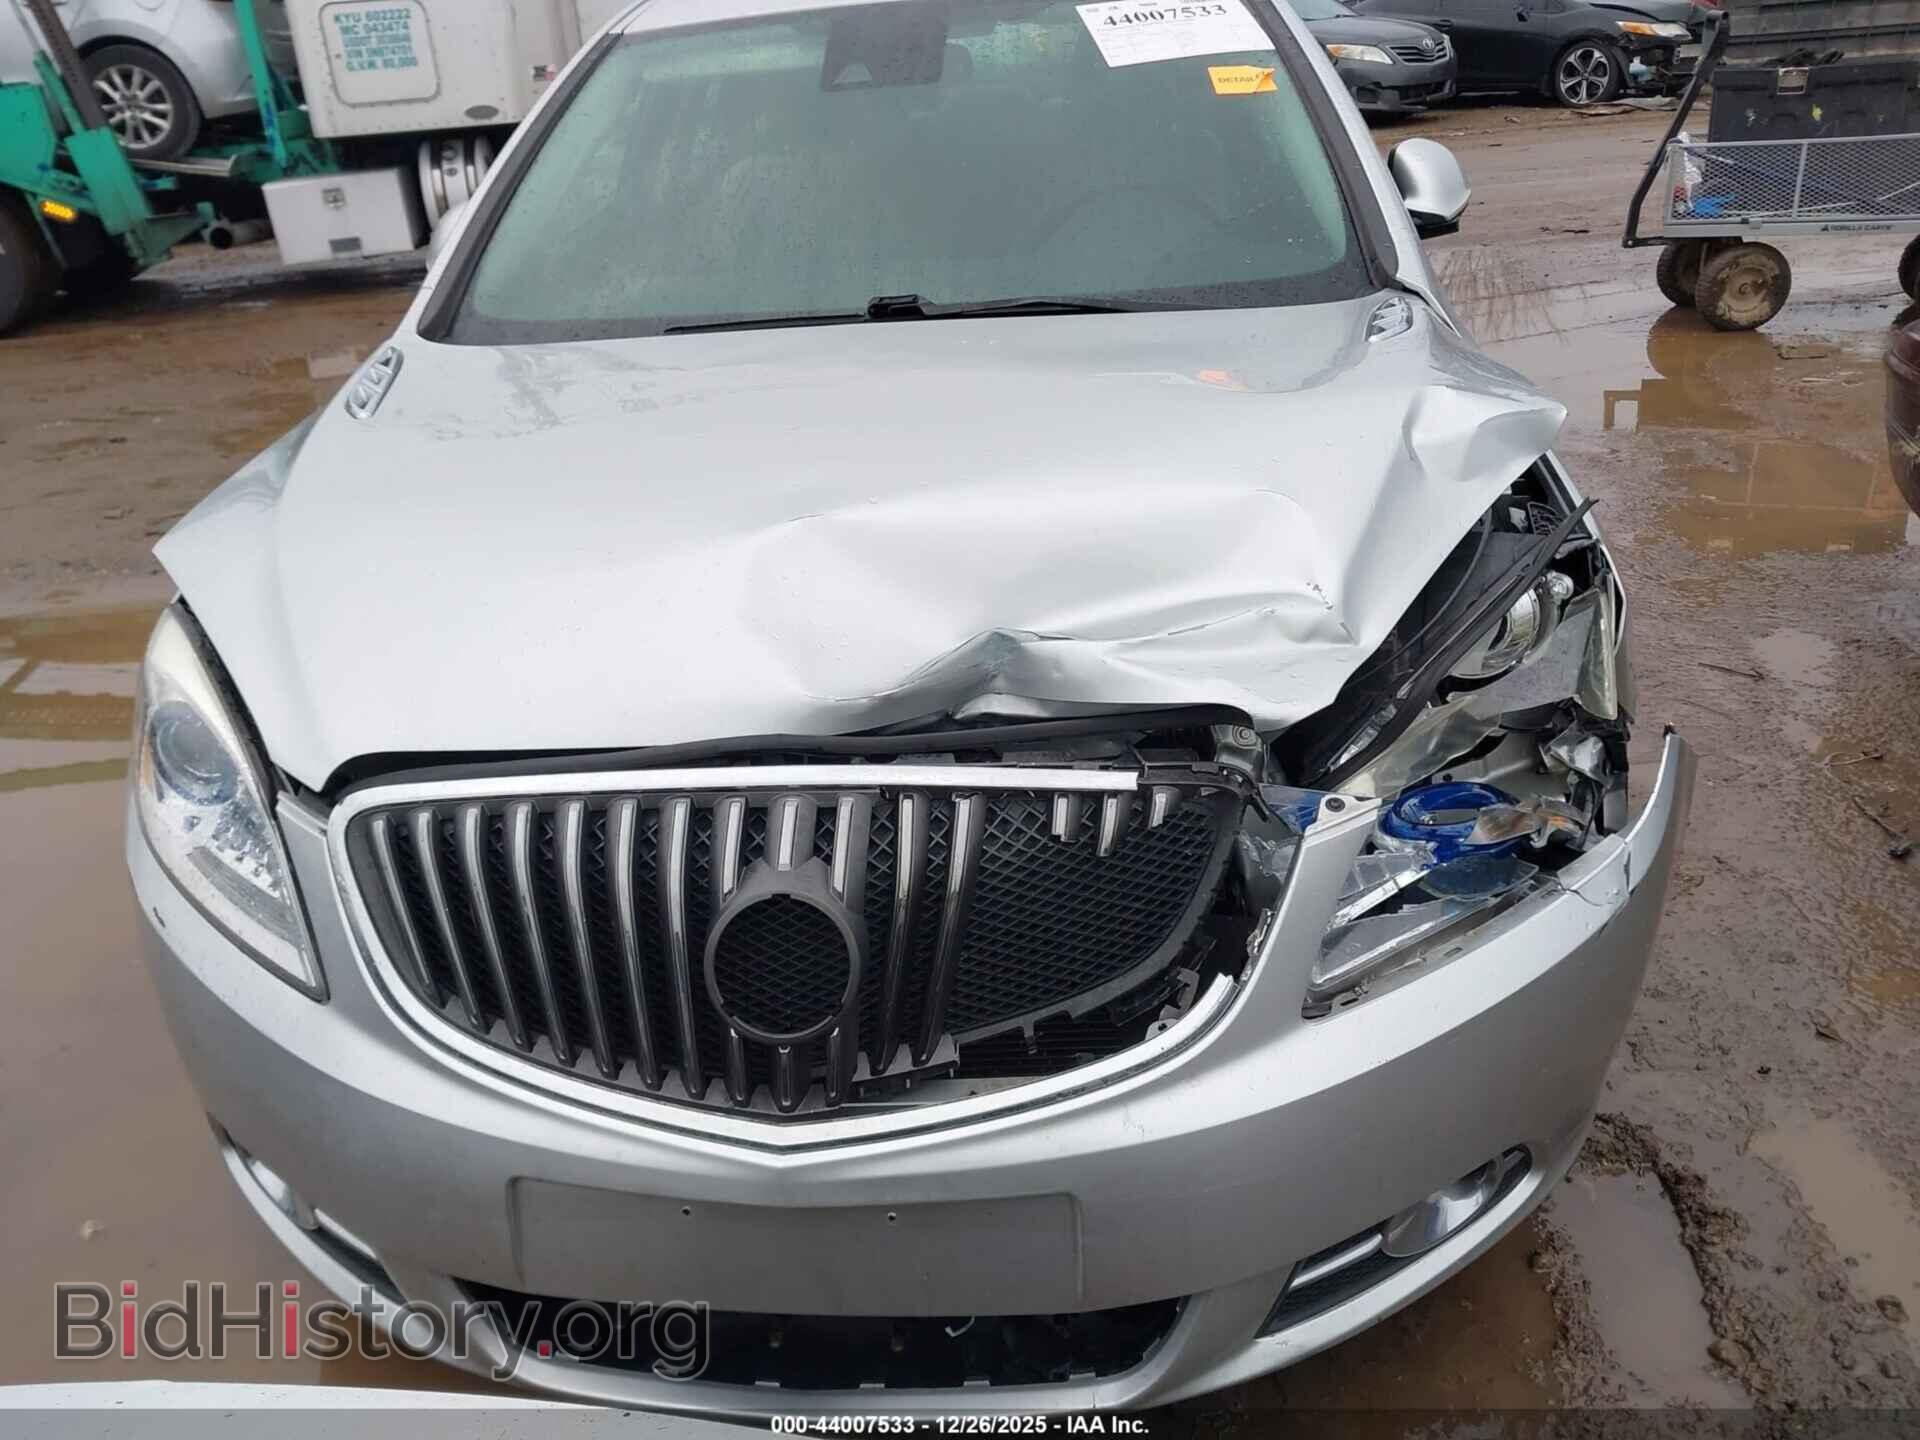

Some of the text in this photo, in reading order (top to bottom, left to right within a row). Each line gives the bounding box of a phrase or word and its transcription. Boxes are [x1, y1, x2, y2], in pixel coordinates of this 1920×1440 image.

[334, 14, 361, 24] KYU
[1104, 4, 1227, 27] 44007533
[339, 24, 360, 36] MC
